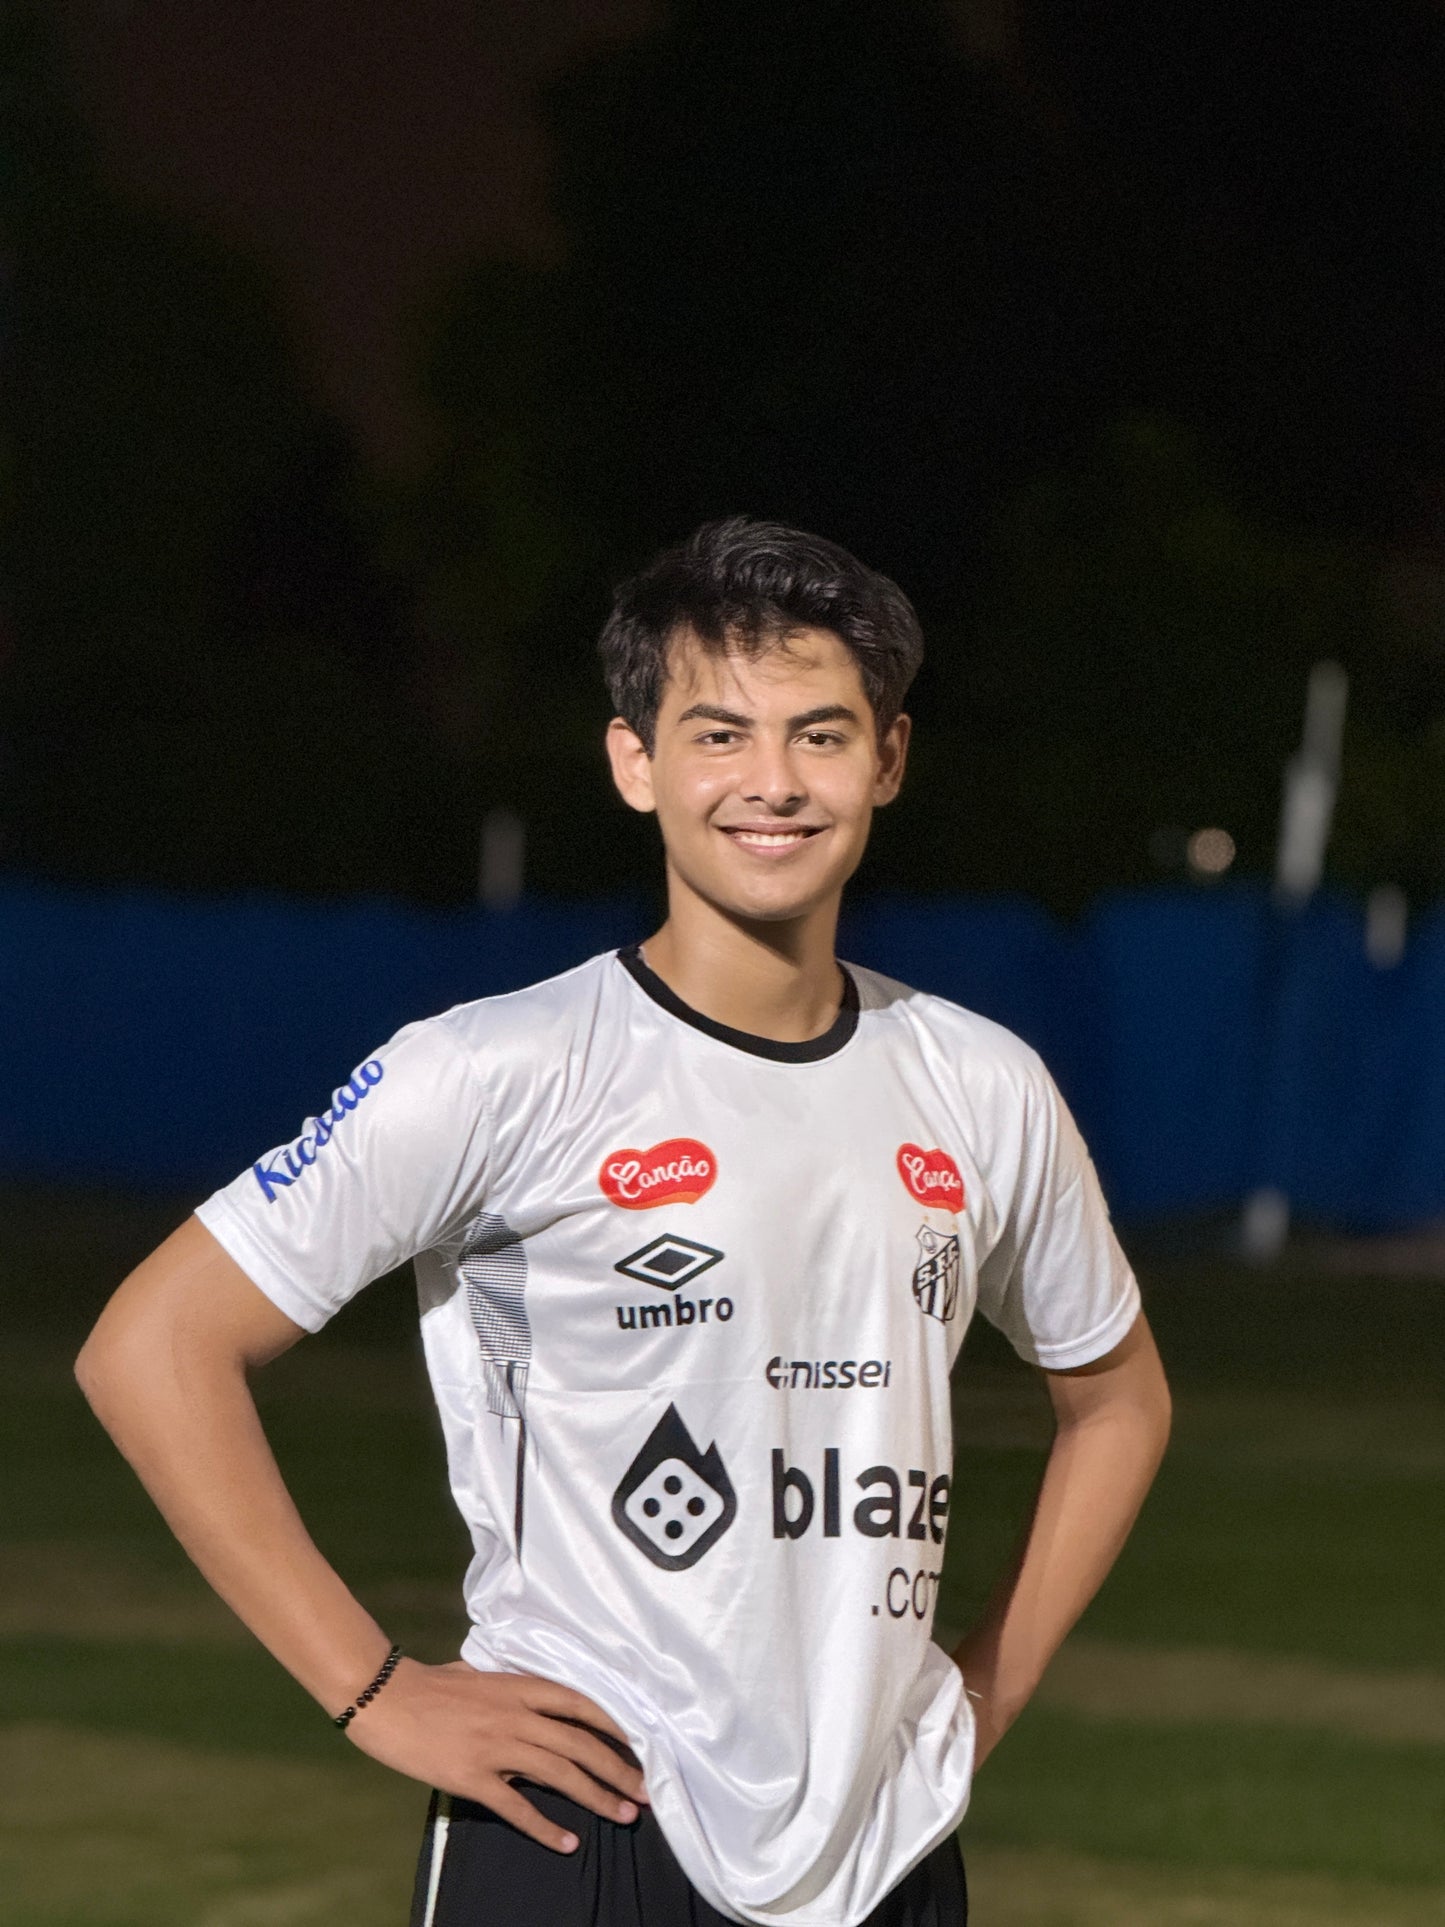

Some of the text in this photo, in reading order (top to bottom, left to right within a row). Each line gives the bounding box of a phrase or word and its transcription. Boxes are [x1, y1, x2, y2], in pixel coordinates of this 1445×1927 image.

[607, 1155, 710, 1199] Canção
[616, 1294, 733, 1330] umbro
[790, 1360, 891, 1389] nissei
[772, 1447, 949, 1544] blaze
